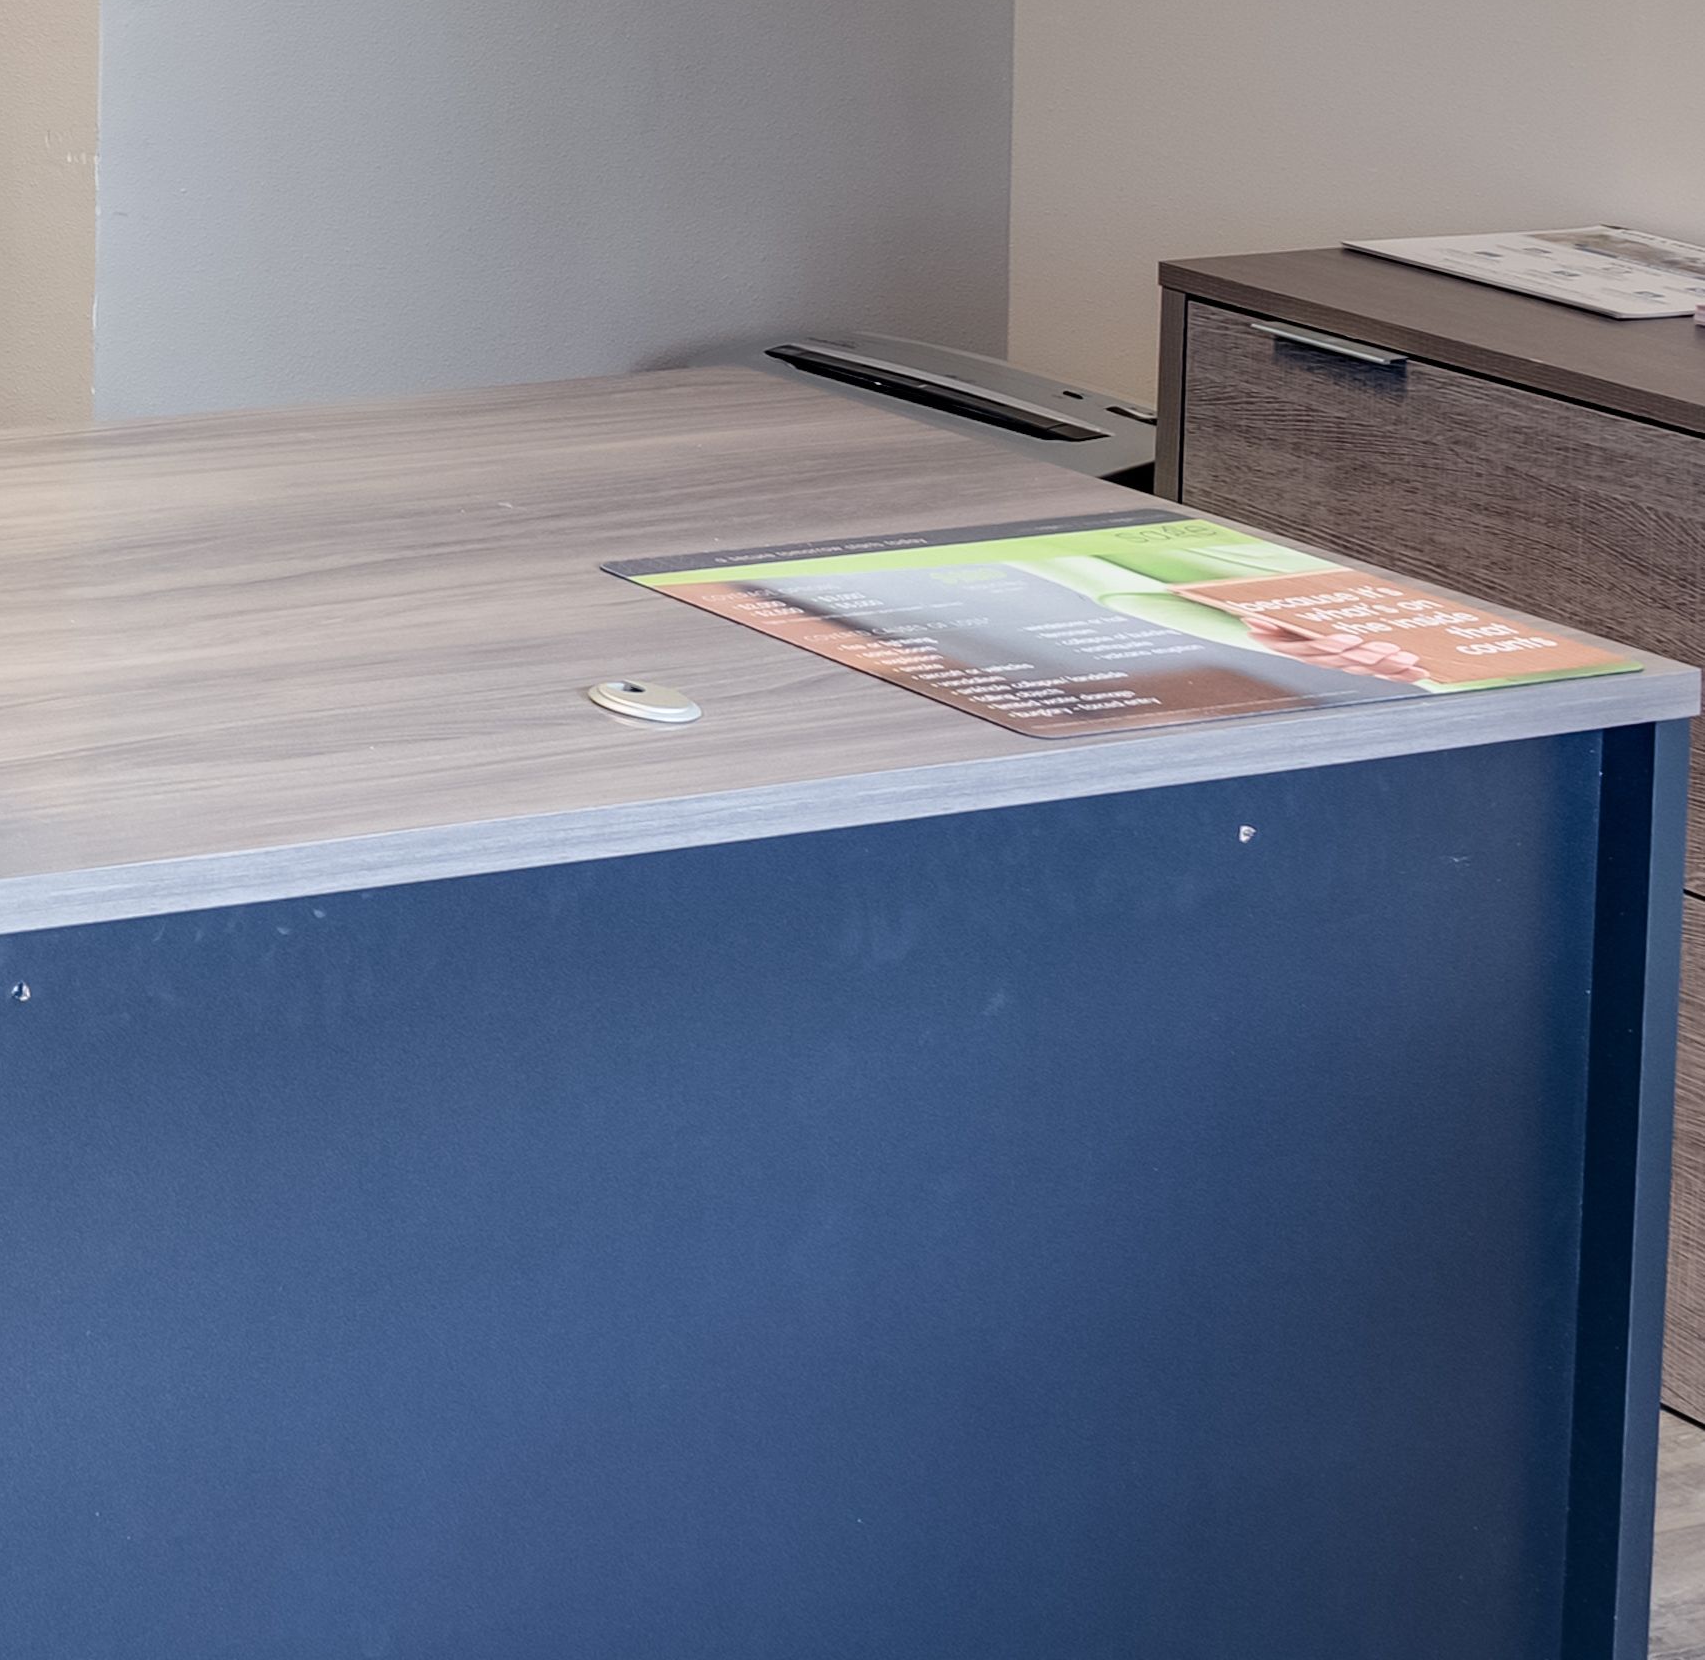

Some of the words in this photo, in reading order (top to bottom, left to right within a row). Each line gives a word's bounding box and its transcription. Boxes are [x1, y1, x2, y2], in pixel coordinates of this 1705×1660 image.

[1225, 588, 1351, 613] because
[1352, 584, 1403, 600] it's
[1294, 601, 1395, 623] what's
[1399, 597, 1445, 613] on
[1331, 619, 1391, 636] the
[1391, 610, 1480, 630] inside
[1444, 622, 1519, 641] that
[1455, 636, 1559, 656] counts
